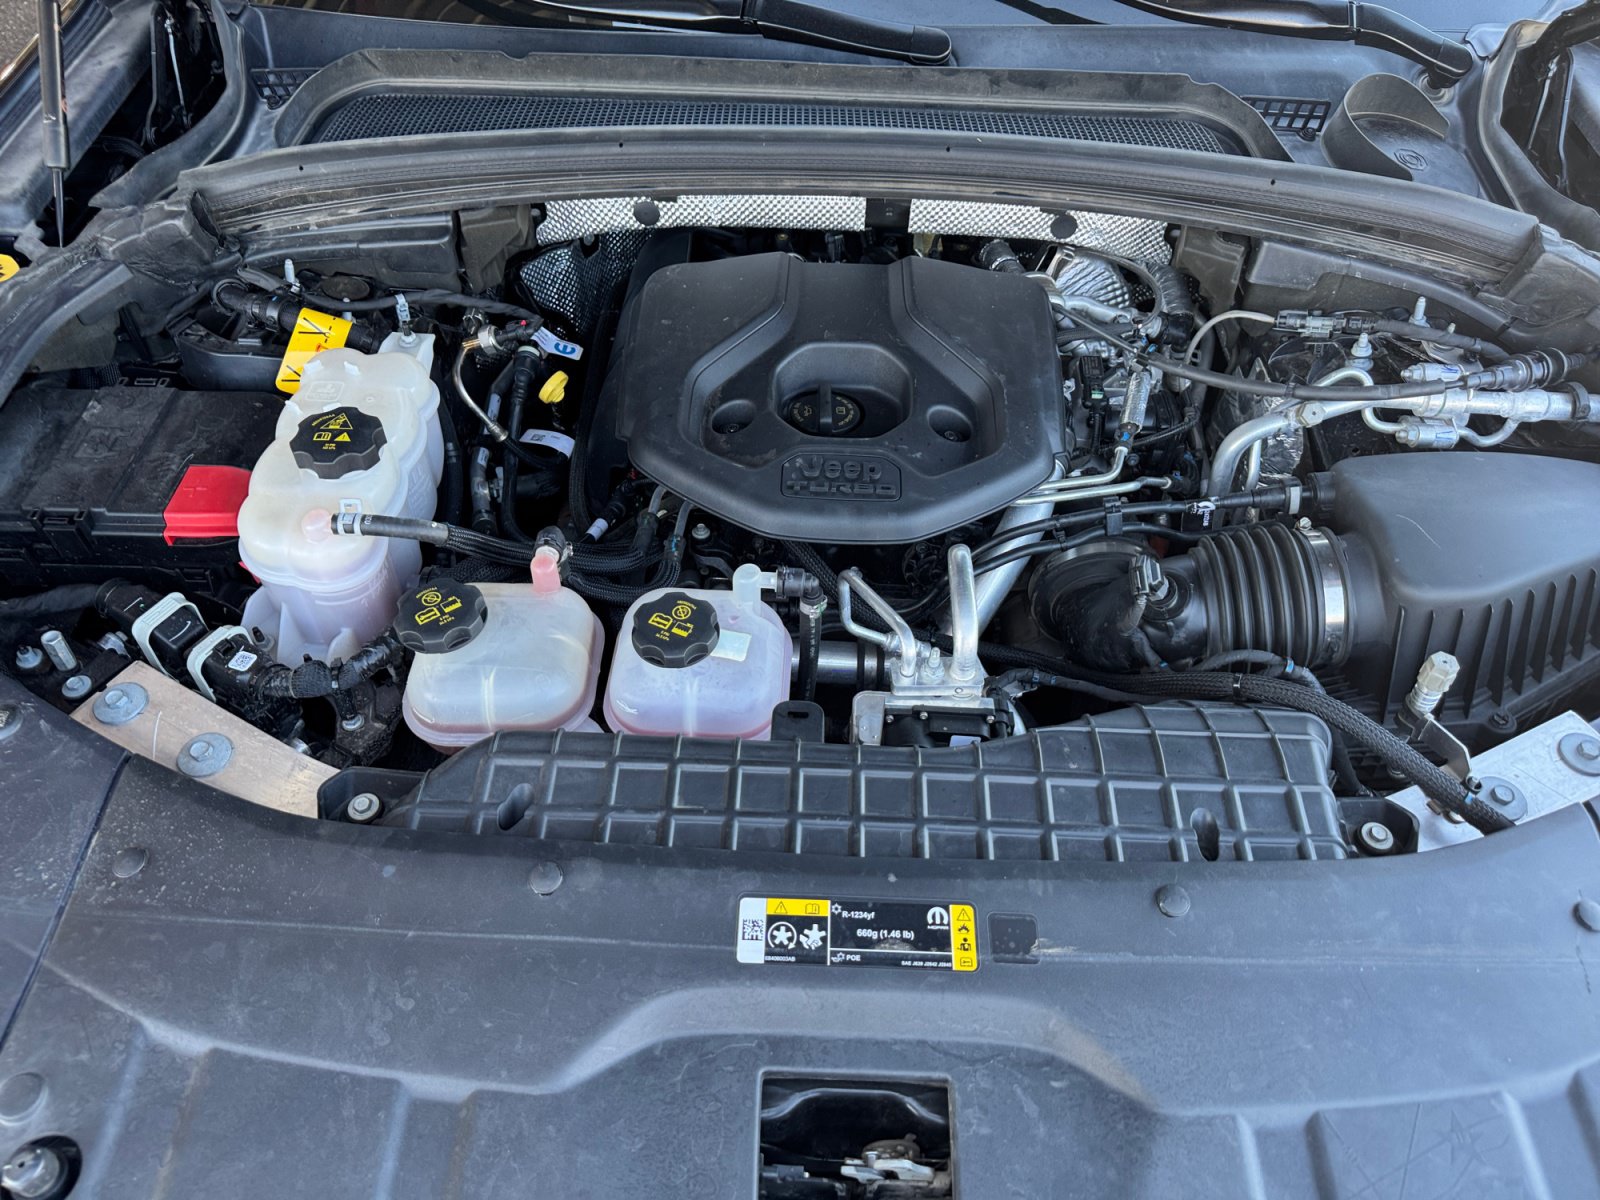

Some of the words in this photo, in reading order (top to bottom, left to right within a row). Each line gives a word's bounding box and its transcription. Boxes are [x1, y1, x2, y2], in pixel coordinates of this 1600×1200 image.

[798, 456, 882, 482] Jeep
[787, 480, 897, 496] TURBO
[842, 910, 875, 921] R-1234yf
[856, 928, 878, 939] 660g
[879, 929, 901, 939] (1.46
[903, 930, 915, 940] lb)
[846, 954, 861, 962] POE
